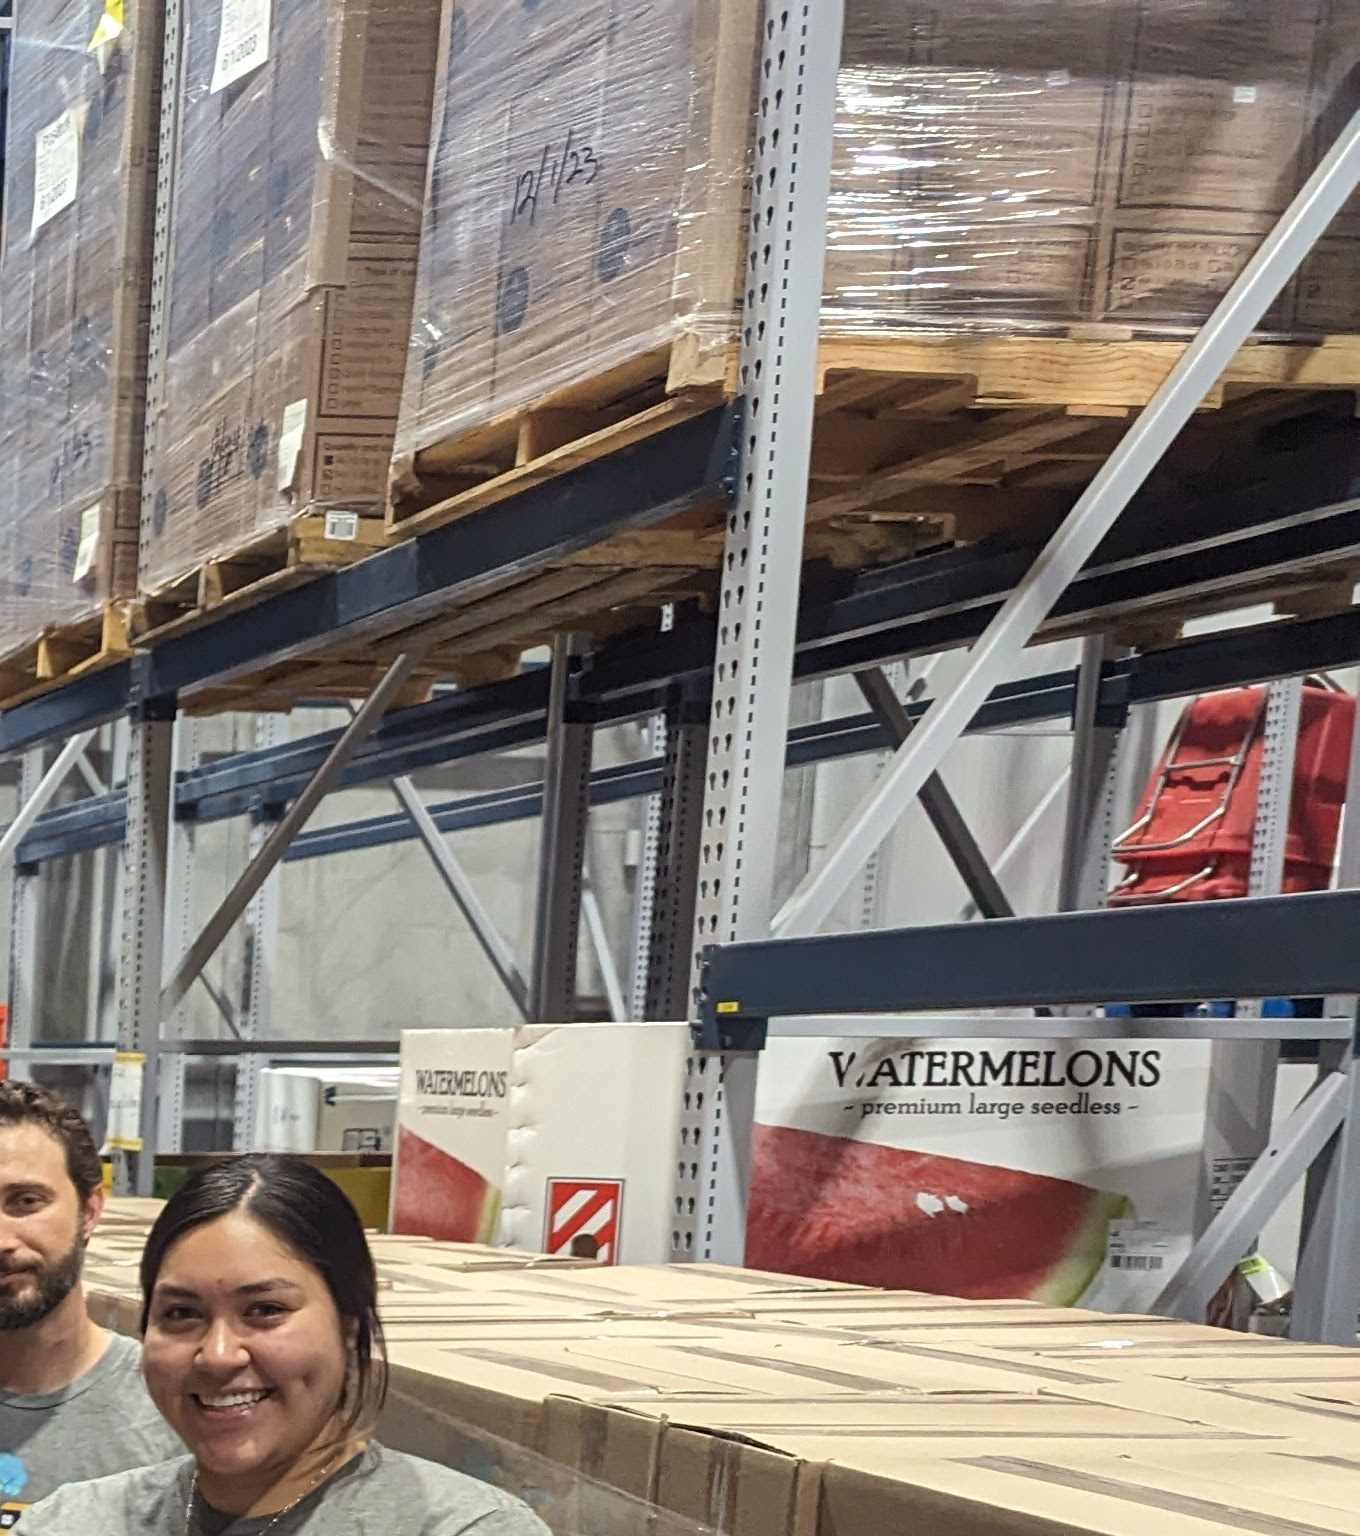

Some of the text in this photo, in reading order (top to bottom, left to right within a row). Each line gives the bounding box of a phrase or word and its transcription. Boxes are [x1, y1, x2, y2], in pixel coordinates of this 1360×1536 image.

[510, 129, 599, 225] 12/1/23
[416, 1069, 508, 1098] WATERMELONS
[861, 1093, 1121, 1119] premium large seedless
